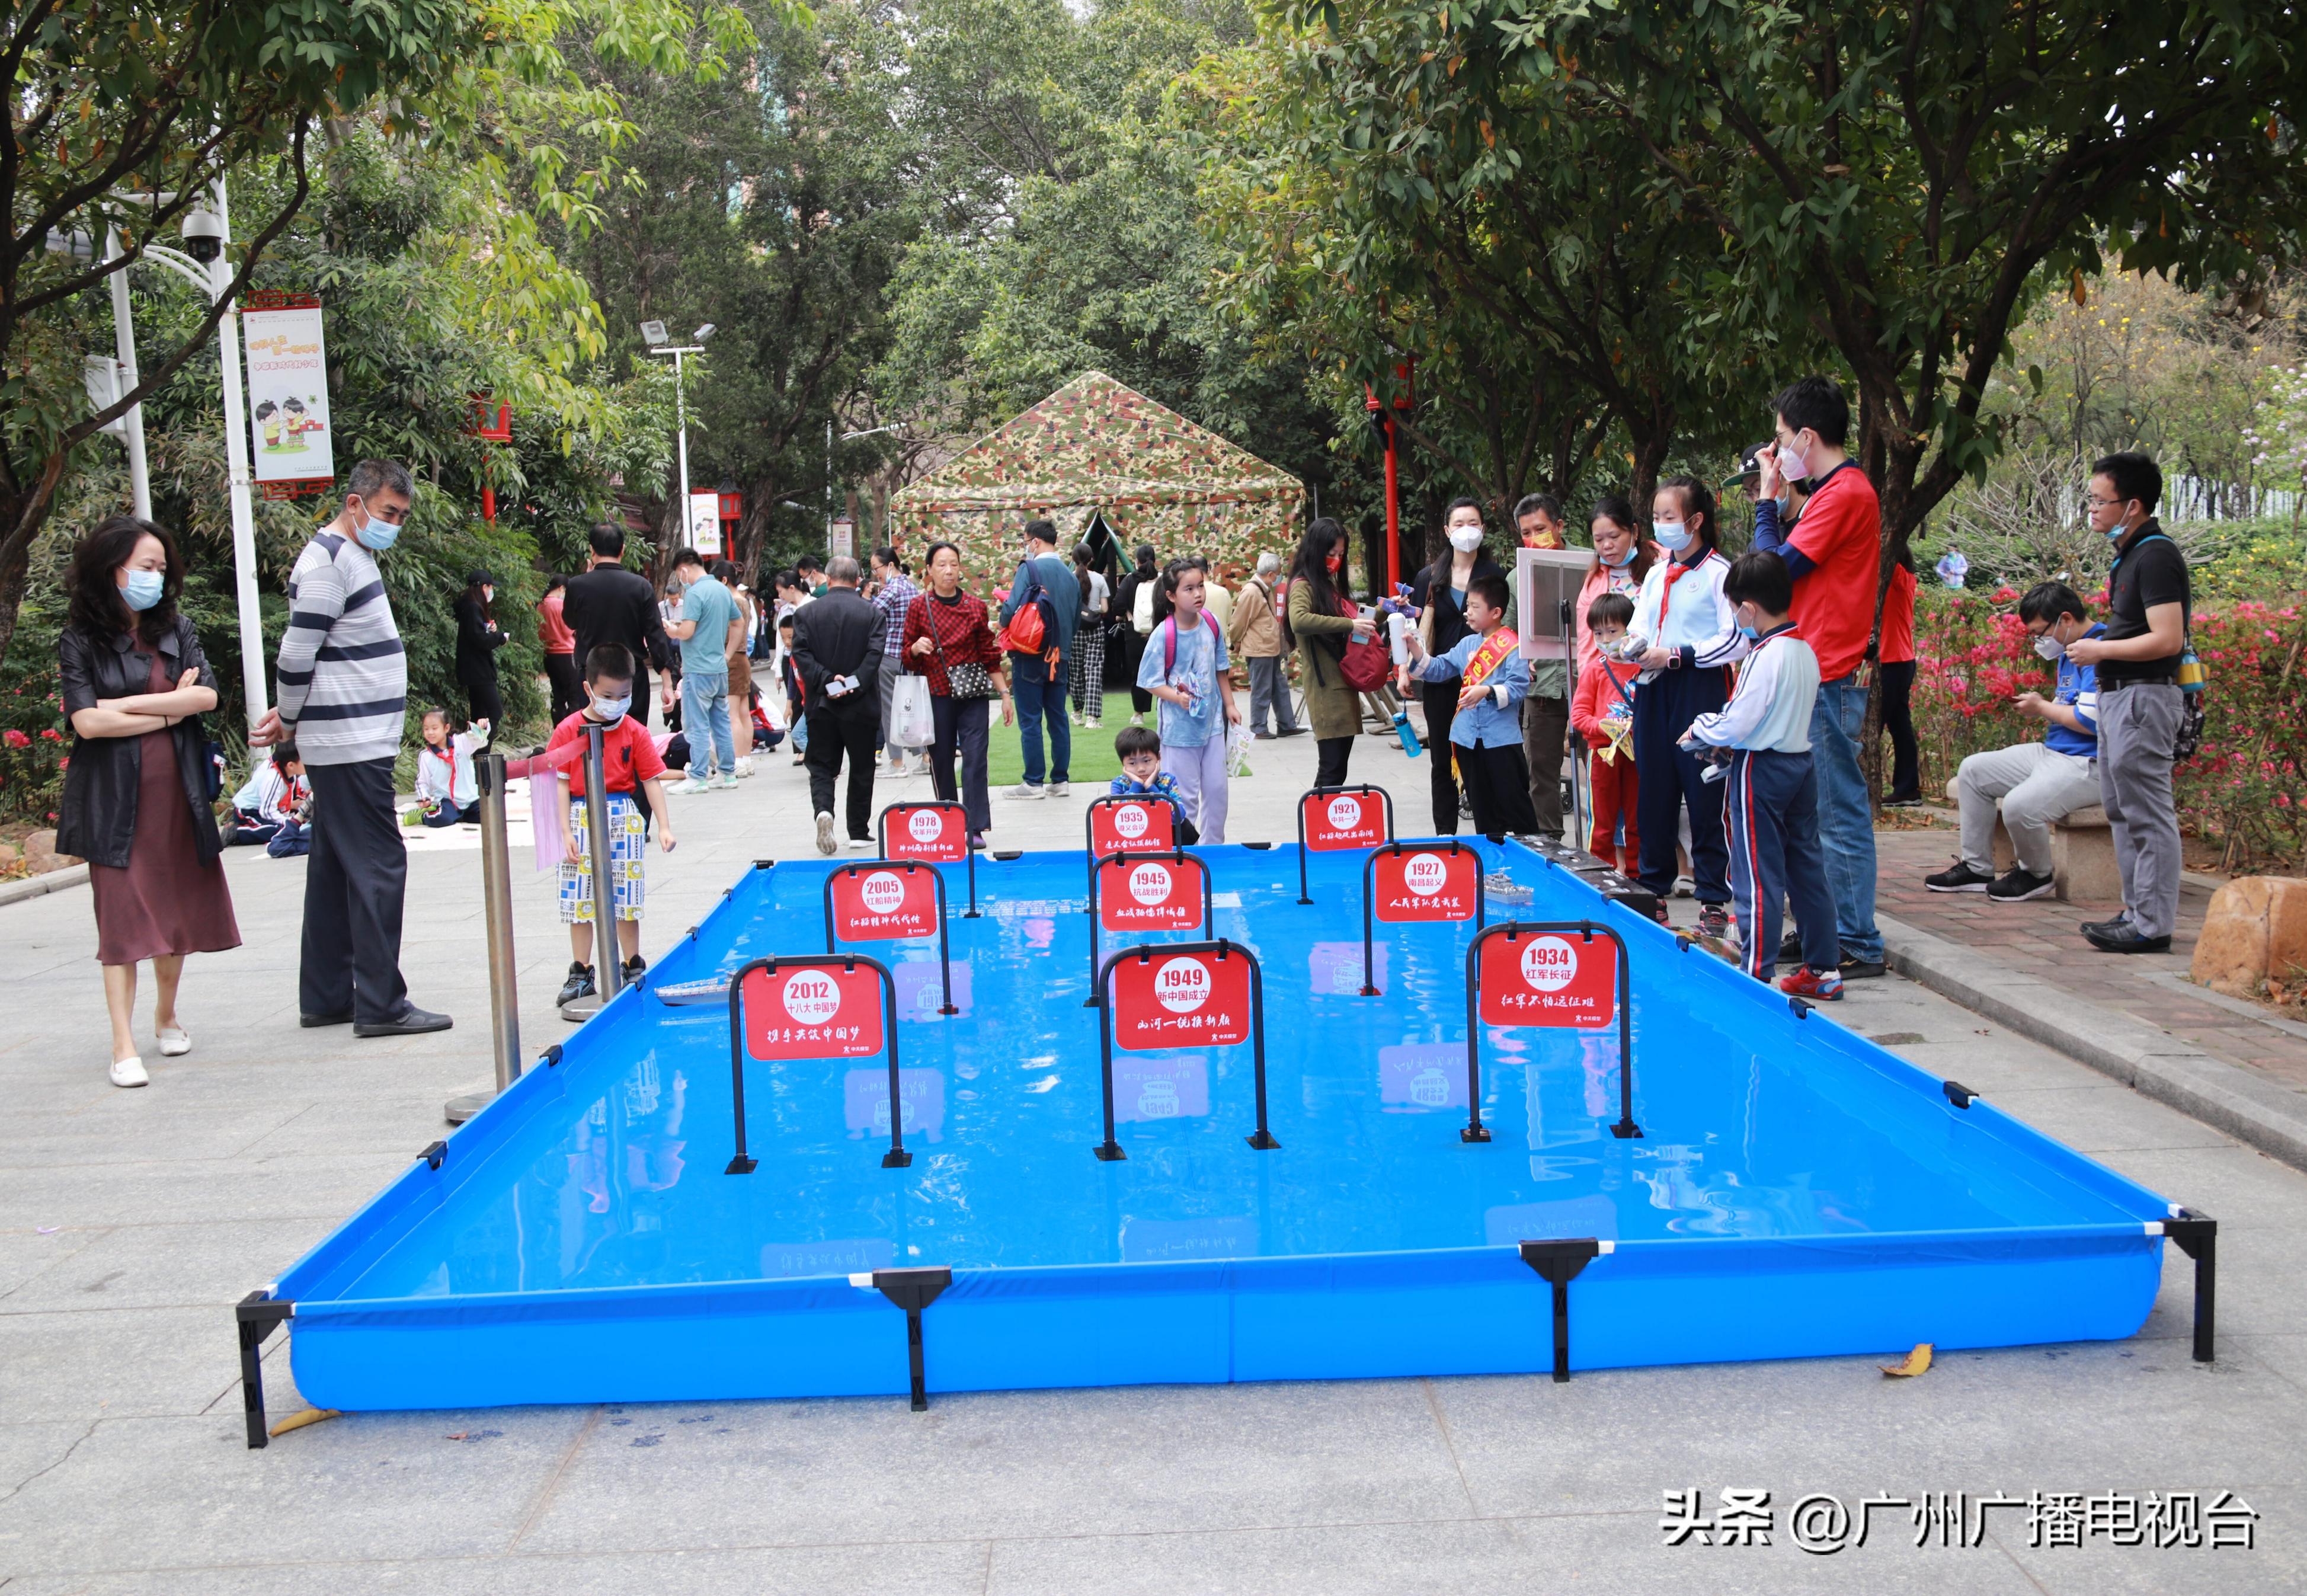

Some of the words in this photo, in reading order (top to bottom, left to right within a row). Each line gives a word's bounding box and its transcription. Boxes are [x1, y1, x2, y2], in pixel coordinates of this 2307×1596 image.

[1333, 804, 1355, 814] 1921
[914, 817, 936, 826] 1978
[1119, 812, 1143, 822] 1935
[1331, 815, 1358, 823] 中共一大
[1412, 863, 1439, 875] 1927
[1135, 872, 1165, 885] 1945
[1408, 878, 1442, 887] 南昌起义
[867, 881, 898, 894] 2005
[1133, 888, 1168, 896] 抗战胜利
[866, 895, 901, 906] 红船精神
[850, 914, 920, 927] 红船精神代代传
[1529, 948, 1569, 965] 1934
[1162, 968, 1203, 987] 1949
[1525, 968, 1572, 980] 红军长征
[790, 982, 828, 999] 2012
[1157, 989, 1208, 1002] 新中国成立
[1501, 993, 1594, 1009] 红军不怕远征难
[787, 1003, 811, 1014] 十八大
[814, 1002, 837, 1013] 中国梦
[1137, 1013, 1230, 1031] 山河一统换新颜
[767, 1025, 860, 1043] 携手共筑中国梦
